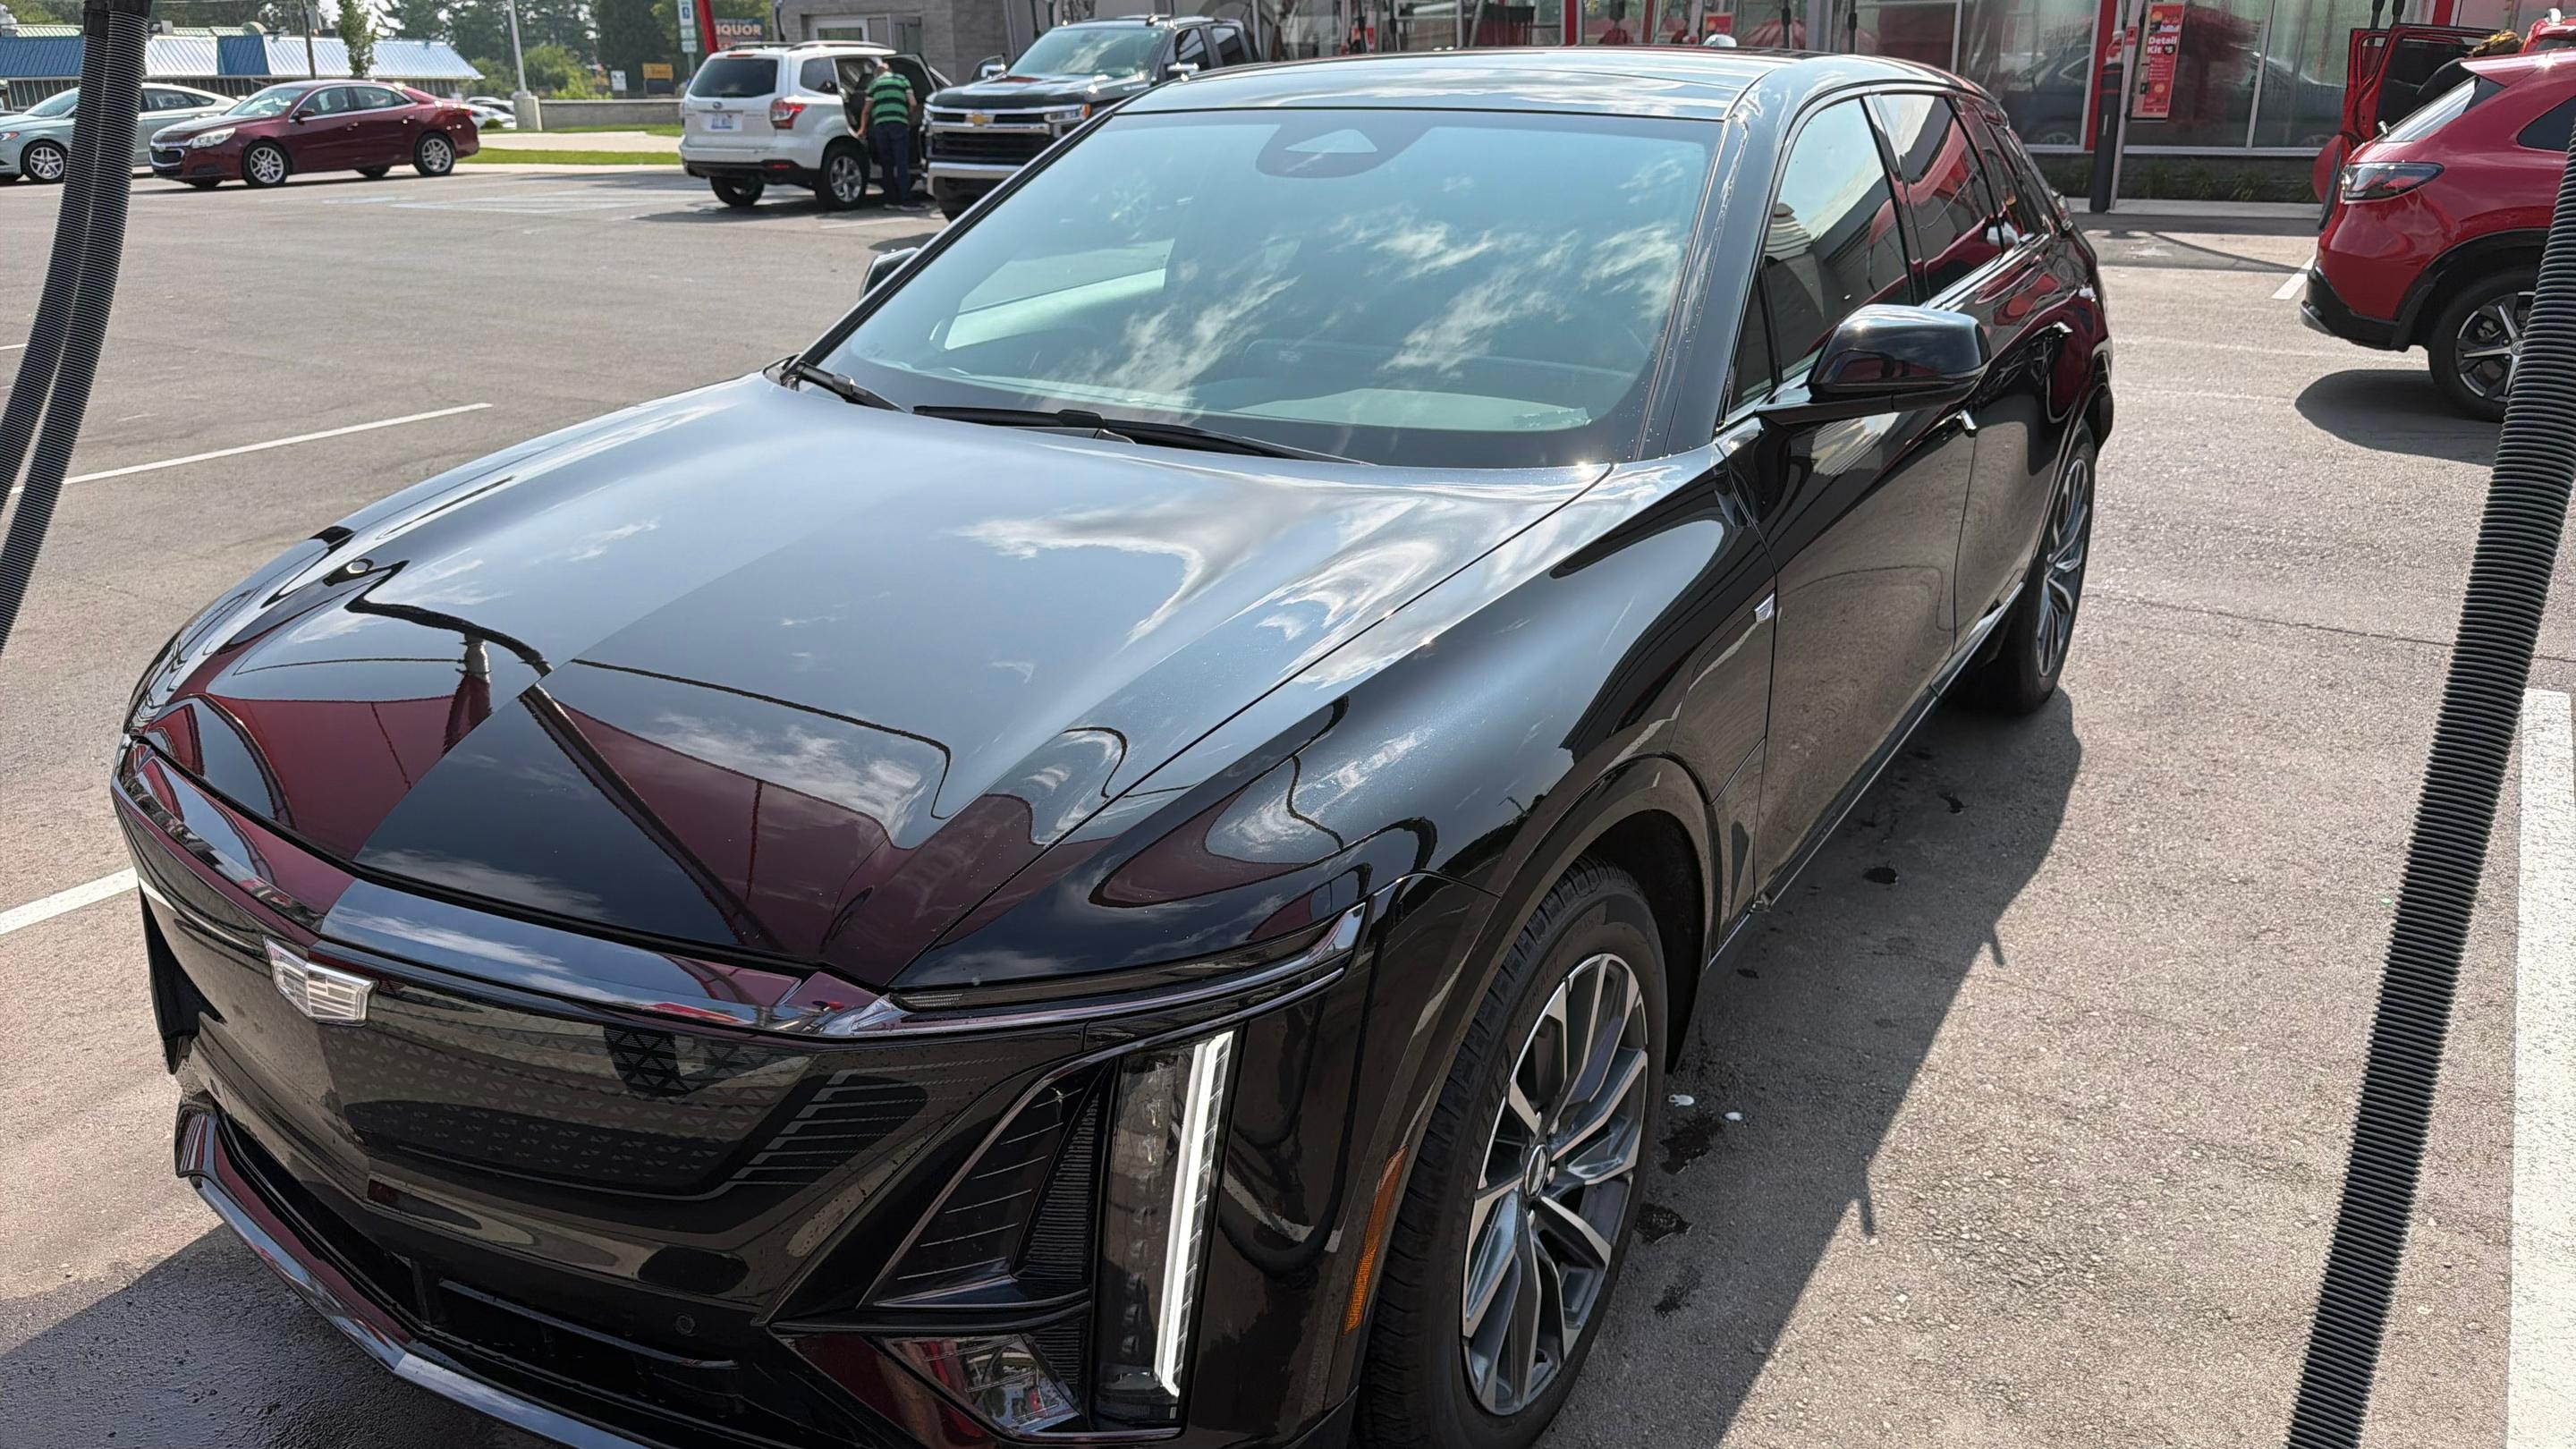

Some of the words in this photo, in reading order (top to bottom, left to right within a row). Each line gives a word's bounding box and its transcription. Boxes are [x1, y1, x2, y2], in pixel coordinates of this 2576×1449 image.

[716, 24, 762, 36] IQUOR
[2148, 36, 2178, 45] Detail
[2147, 46, 2162, 54] Kit
[1514, 952, 1560, 1031] PRIMACY
